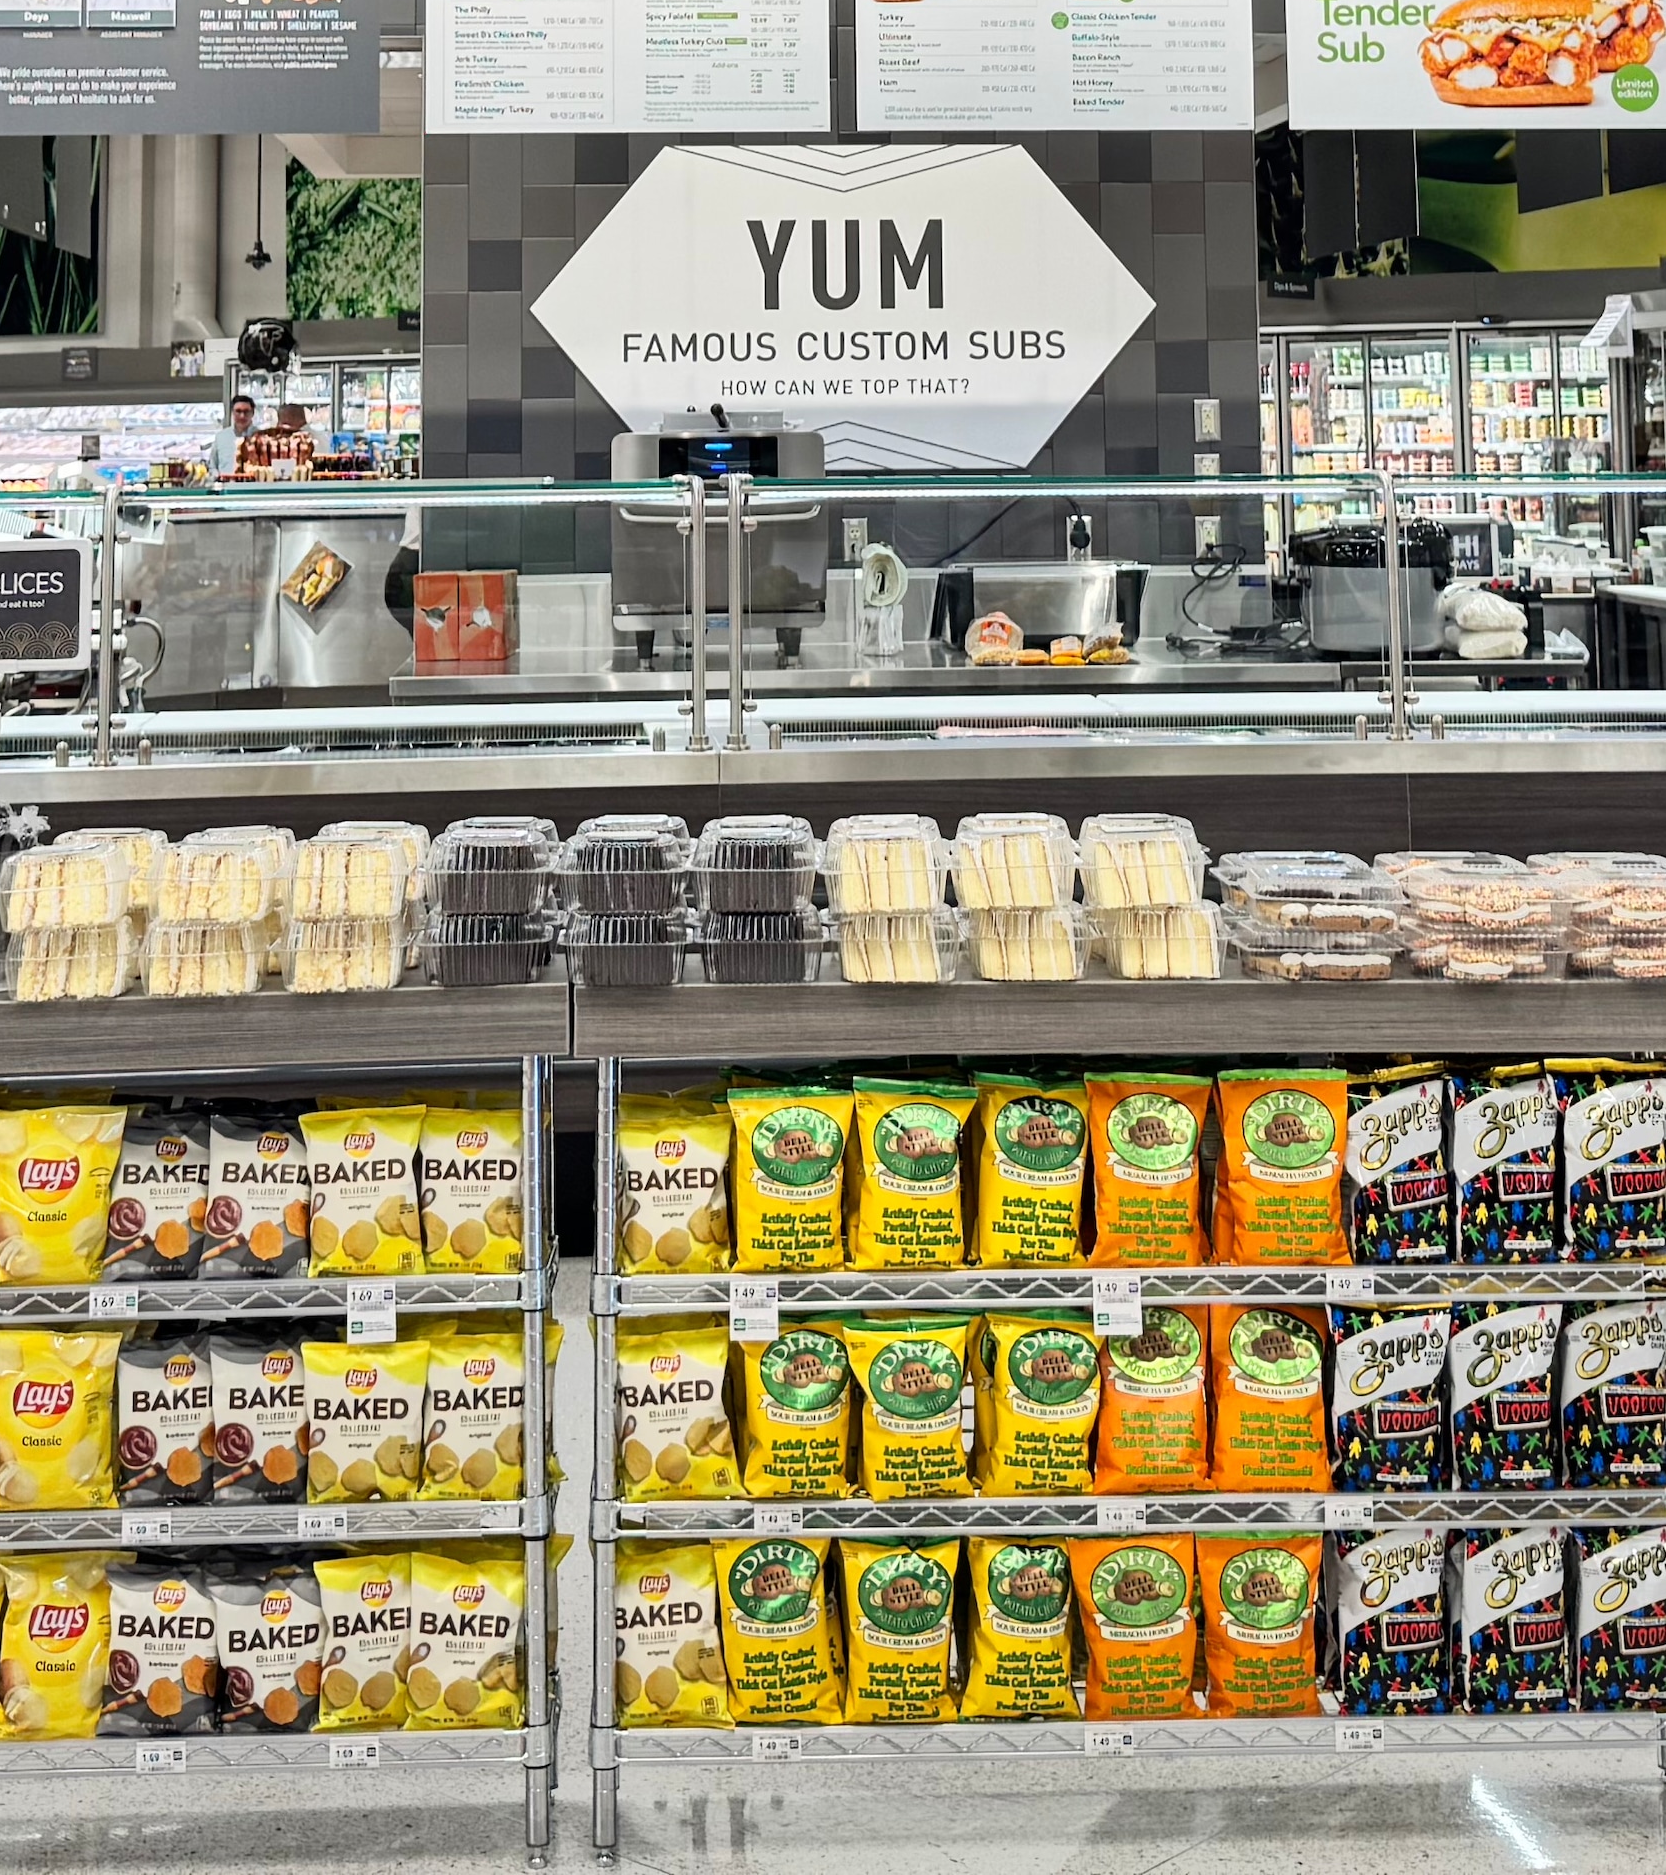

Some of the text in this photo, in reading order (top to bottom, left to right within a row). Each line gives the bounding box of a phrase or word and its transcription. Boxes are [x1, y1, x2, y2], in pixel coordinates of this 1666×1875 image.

[1316, 31, 1386, 63] Sub
[1616, 78, 1654, 90] Limited
[1617, 89, 1653, 100] edition
[745, 218, 946, 312] YUM
[620, 328, 1067, 365] FAMOUS CUSTOM SUBS
[720, 377, 971, 398] HOW CAN WE TOP THAT?
[8, 600, 21, 609] eat
[314, 1158, 406, 1185] BAKED
[424, 1158, 518, 1182] BAKED
[627, 1167, 719, 1192] BAKED
[27, 1209, 68, 1223] Classic
[314, 1397, 409, 1421] BAKED
[1608, 1395, 1665, 1416] VOODOO
[759, 1578, 793, 1593] STYLE
[762, 1570, 787, 1583] DELI
[117, 1614, 215, 1639] BAKED
[228, 1623, 320, 1653] BAKED
